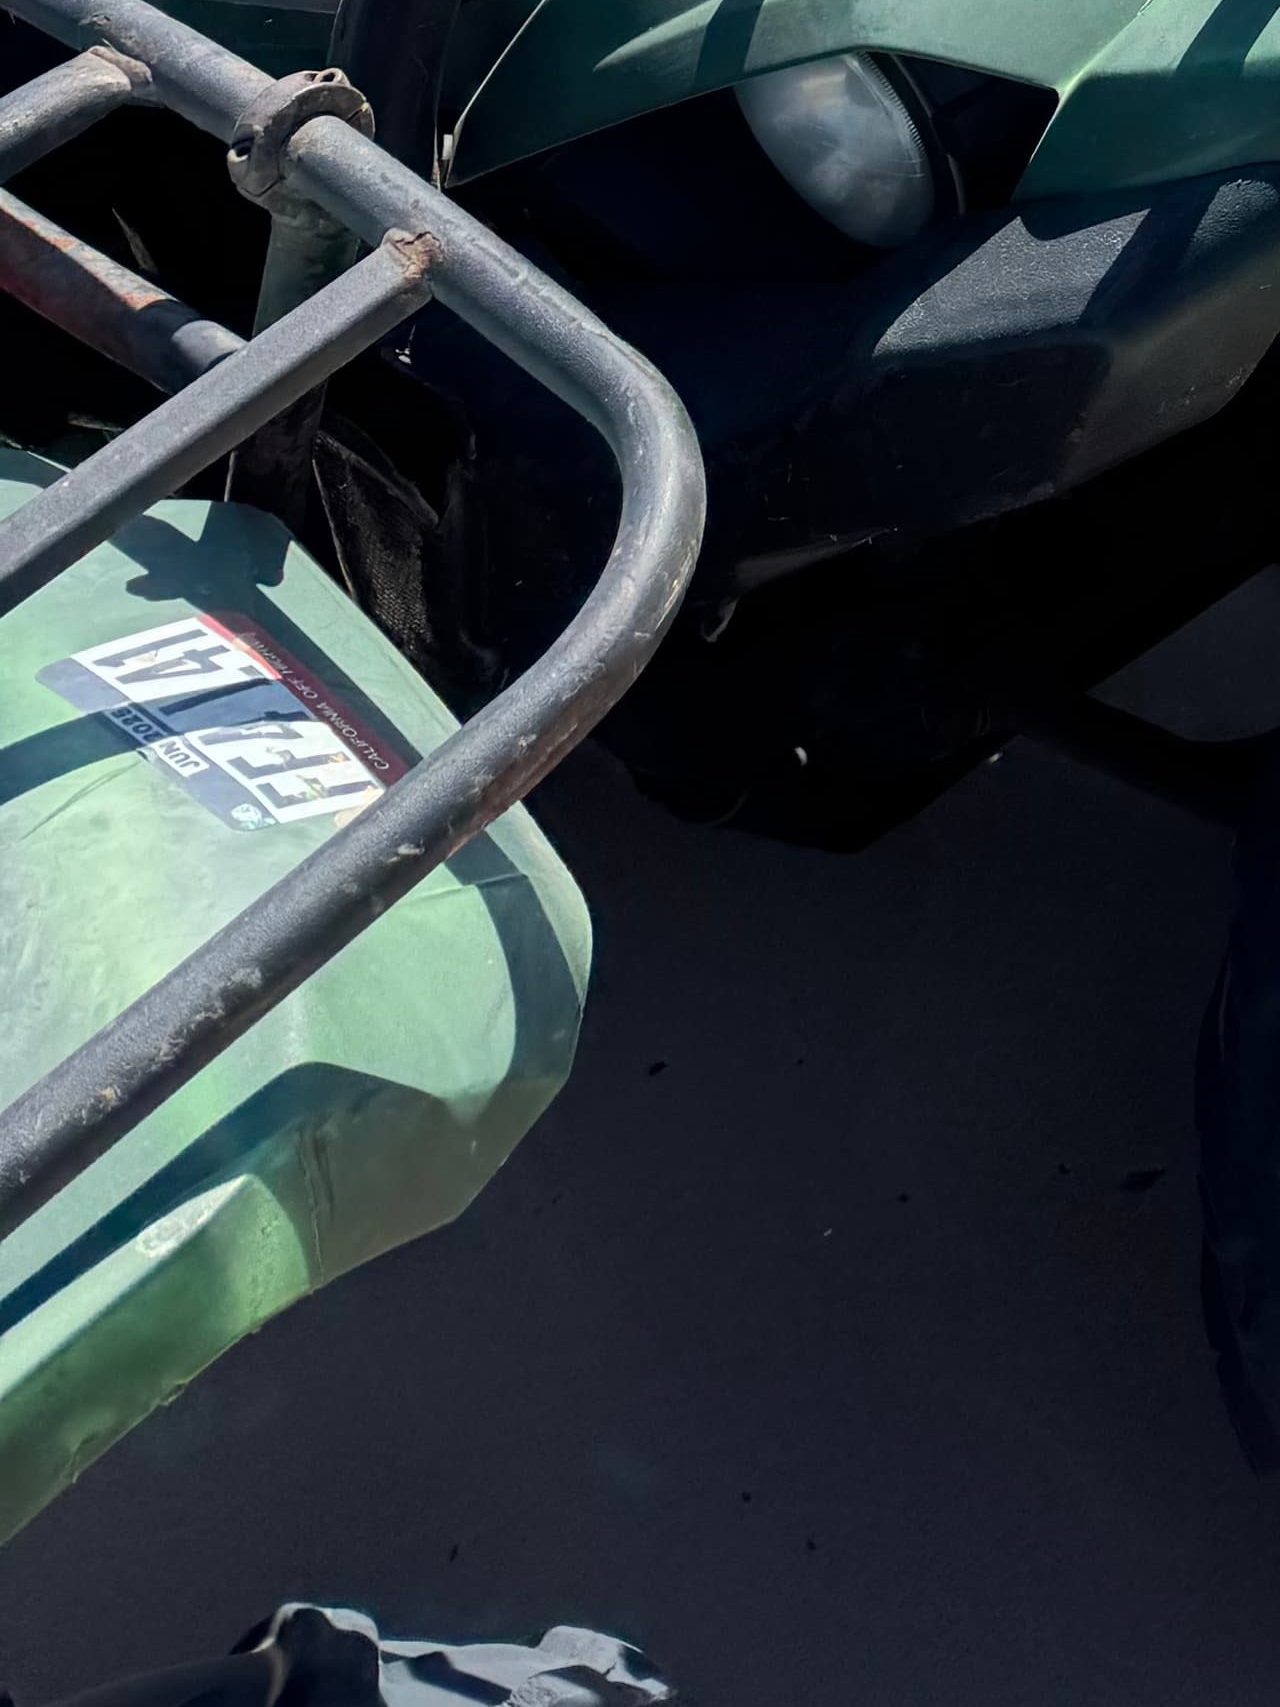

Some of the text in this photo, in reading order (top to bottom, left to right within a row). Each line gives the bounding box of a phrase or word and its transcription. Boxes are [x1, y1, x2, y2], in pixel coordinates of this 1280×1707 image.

[288, 675, 319, 700] OFF
[111, 708, 203, 773] JUN 2025
[316, 701, 390, 771] CALIFORNIA
